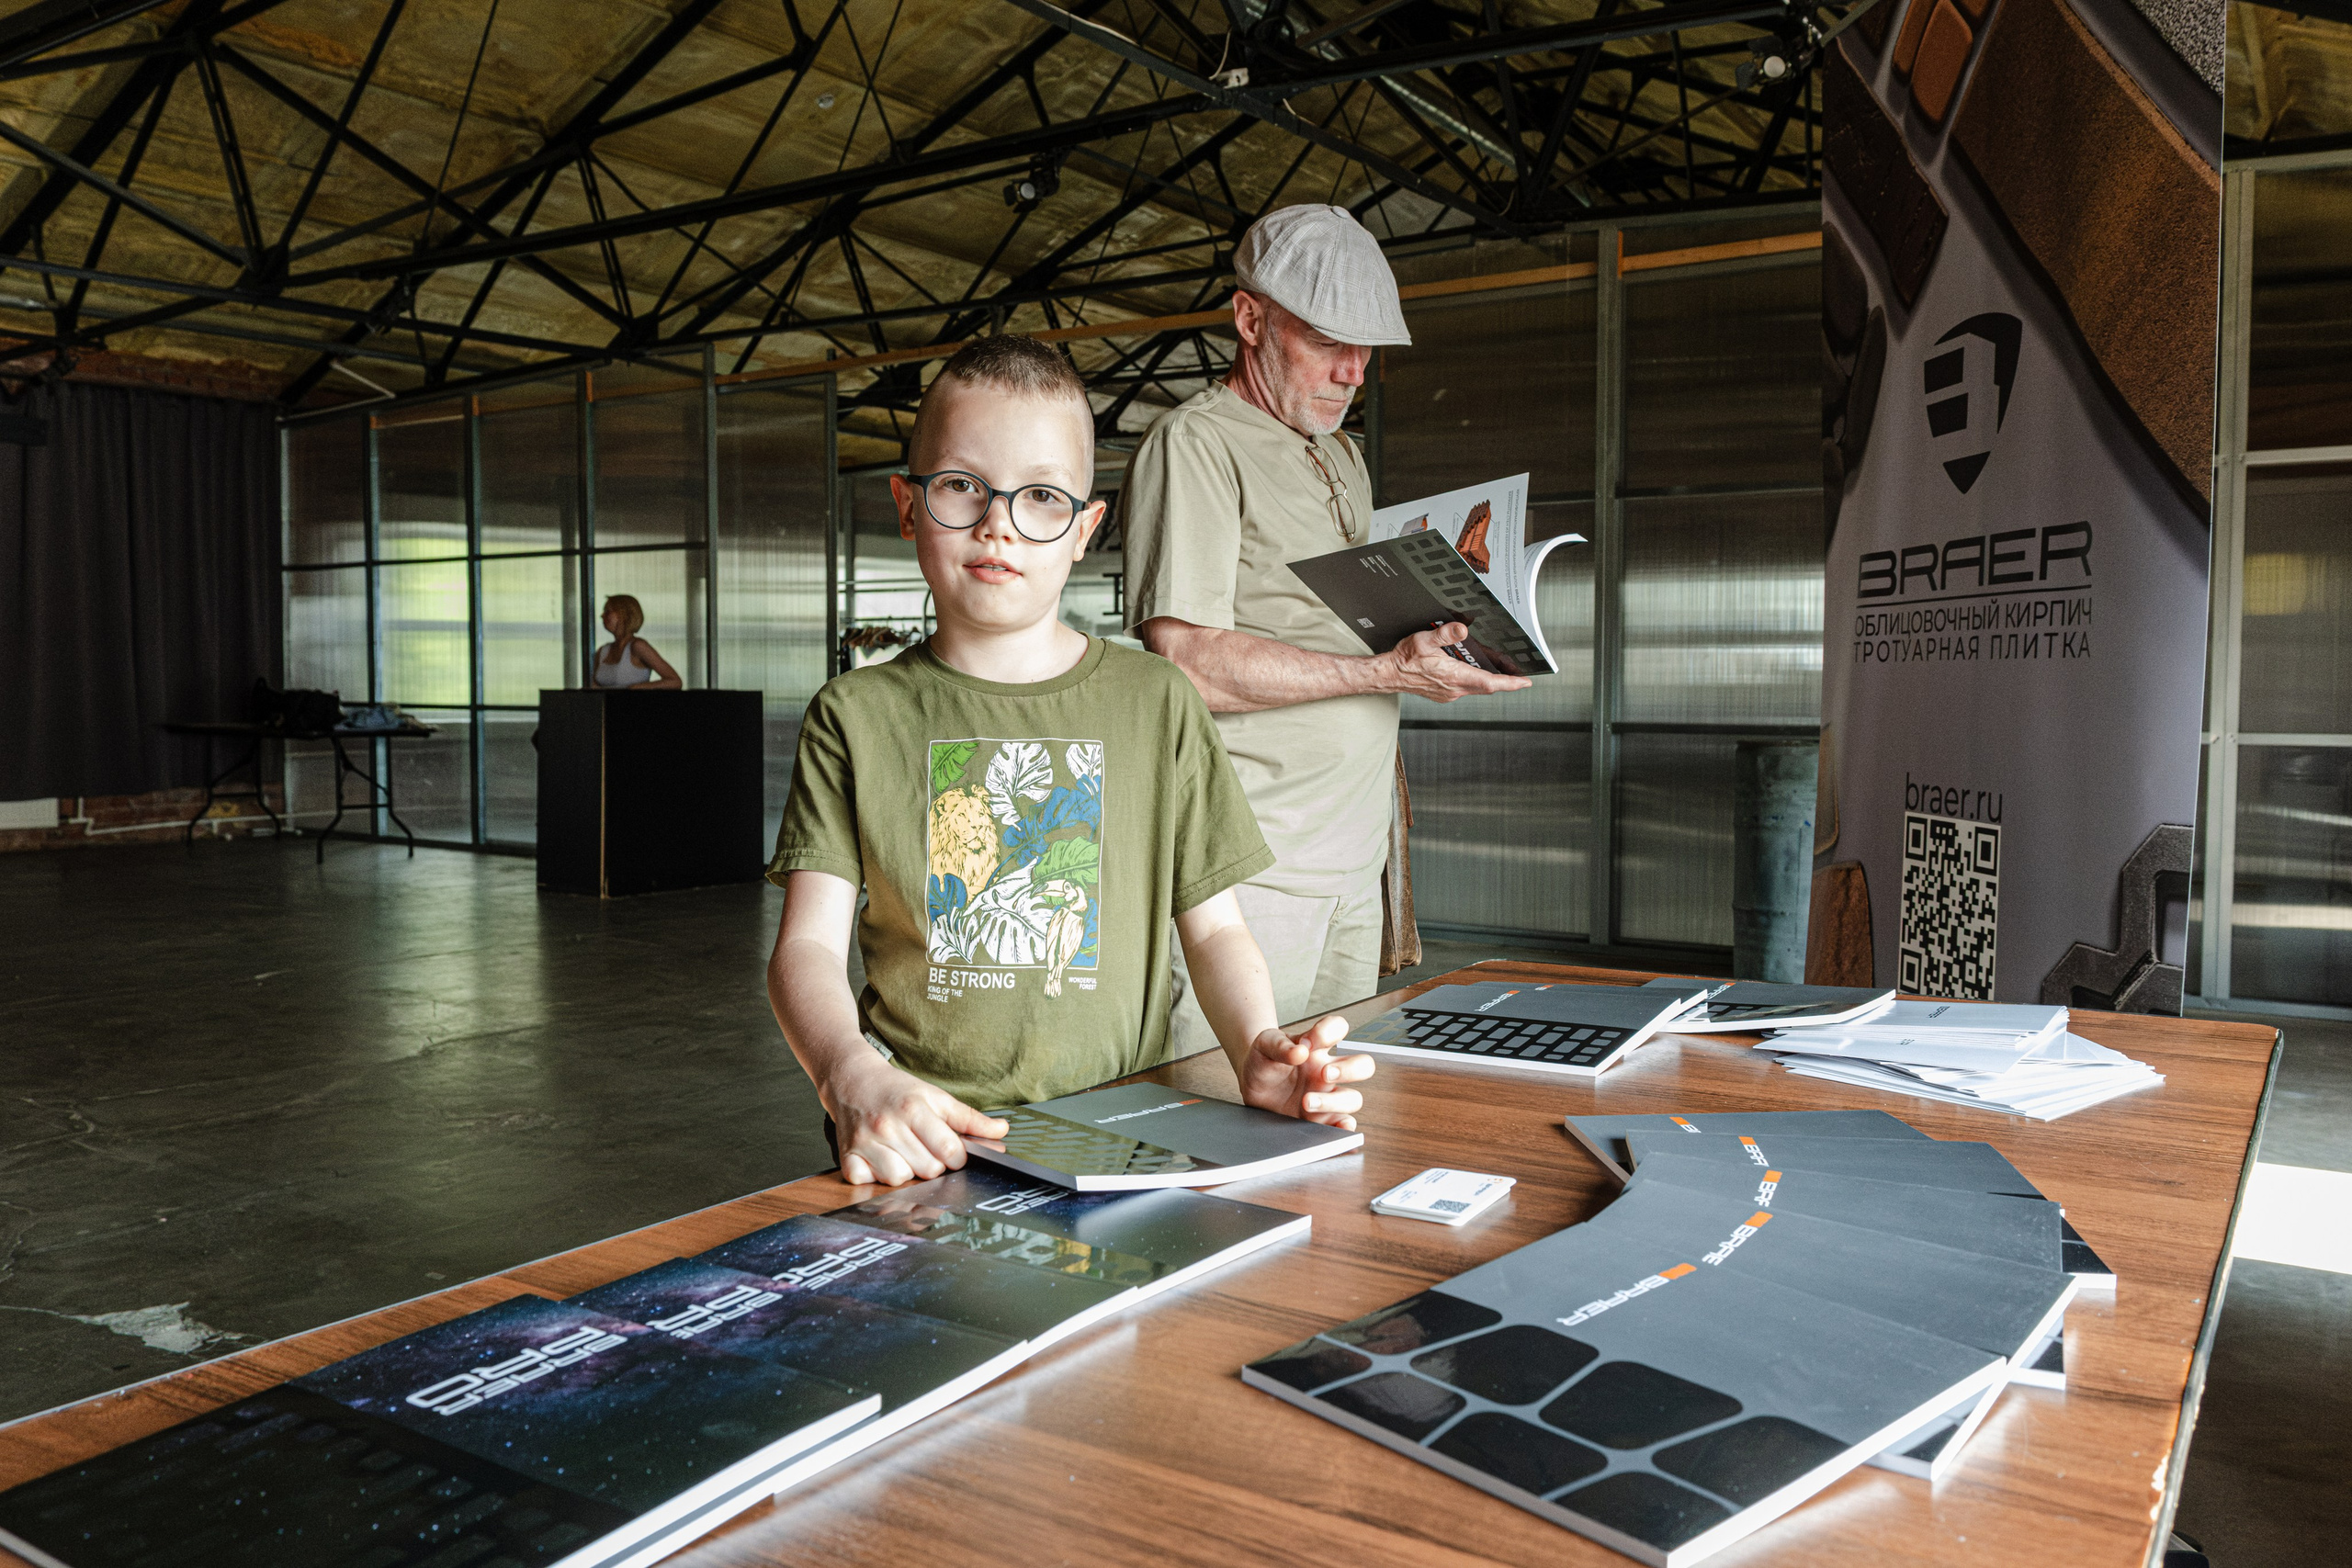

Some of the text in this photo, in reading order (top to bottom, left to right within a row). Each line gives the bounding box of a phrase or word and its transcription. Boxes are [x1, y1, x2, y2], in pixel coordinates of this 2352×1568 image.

[1858, 521, 2093, 597] BRAER
[1855, 597, 2092, 639] ОБЛИЦОВОЧНЫЙ КИРПИЧ
[1853, 631, 2091, 663] ТРОТУАРНАЯ ПЛИТКА
[1905, 772, 2003, 824] braer.ru
[927, 993, 948, 1003] JUNGLE
[928, 985, 942, 994] KING
[951, 988, 963, 998] THE
[929, 966, 1015, 989] BE STRONG
[1744, 1144, 1770, 1168] BRA
[799, 1242, 909, 1291] BRAE
[1702, 1224, 1758, 1266] BRAE
[646, 1284, 763, 1331] PR
[1556, 1274, 1670, 1326] BRAER
[405, 1325, 606, 1408] PRO
[432, 1334, 628, 1416] BRAER
